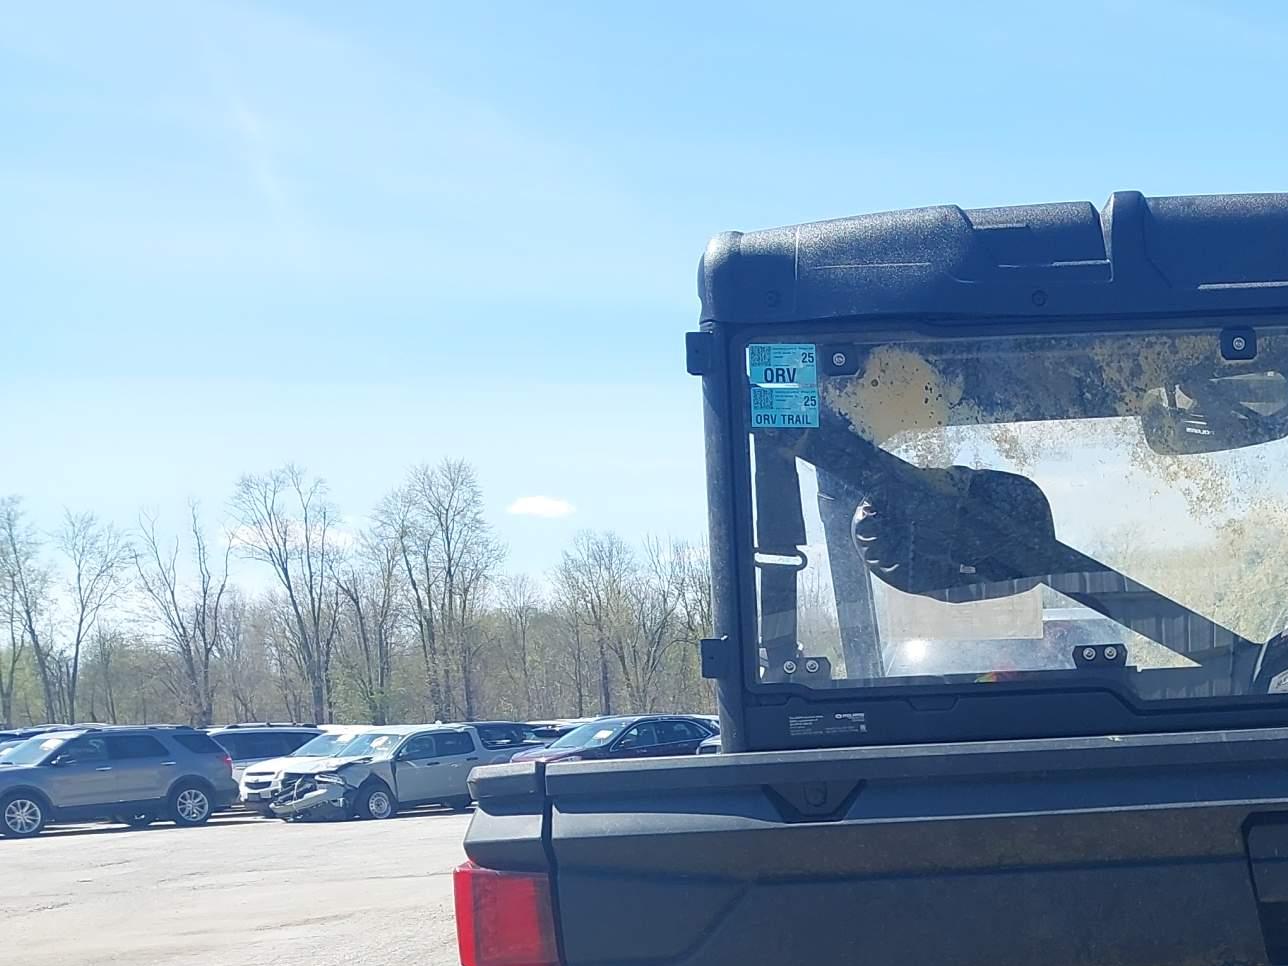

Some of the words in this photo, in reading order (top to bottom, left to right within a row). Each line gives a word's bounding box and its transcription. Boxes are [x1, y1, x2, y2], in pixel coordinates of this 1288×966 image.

[801, 352, 815, 364] 25
[764, 367, 797, 383] ORV
[803, 396, 817, 407] 25
[755, 414, 777, 425] ORV
[781, 414, 812, 425] TRAIL
